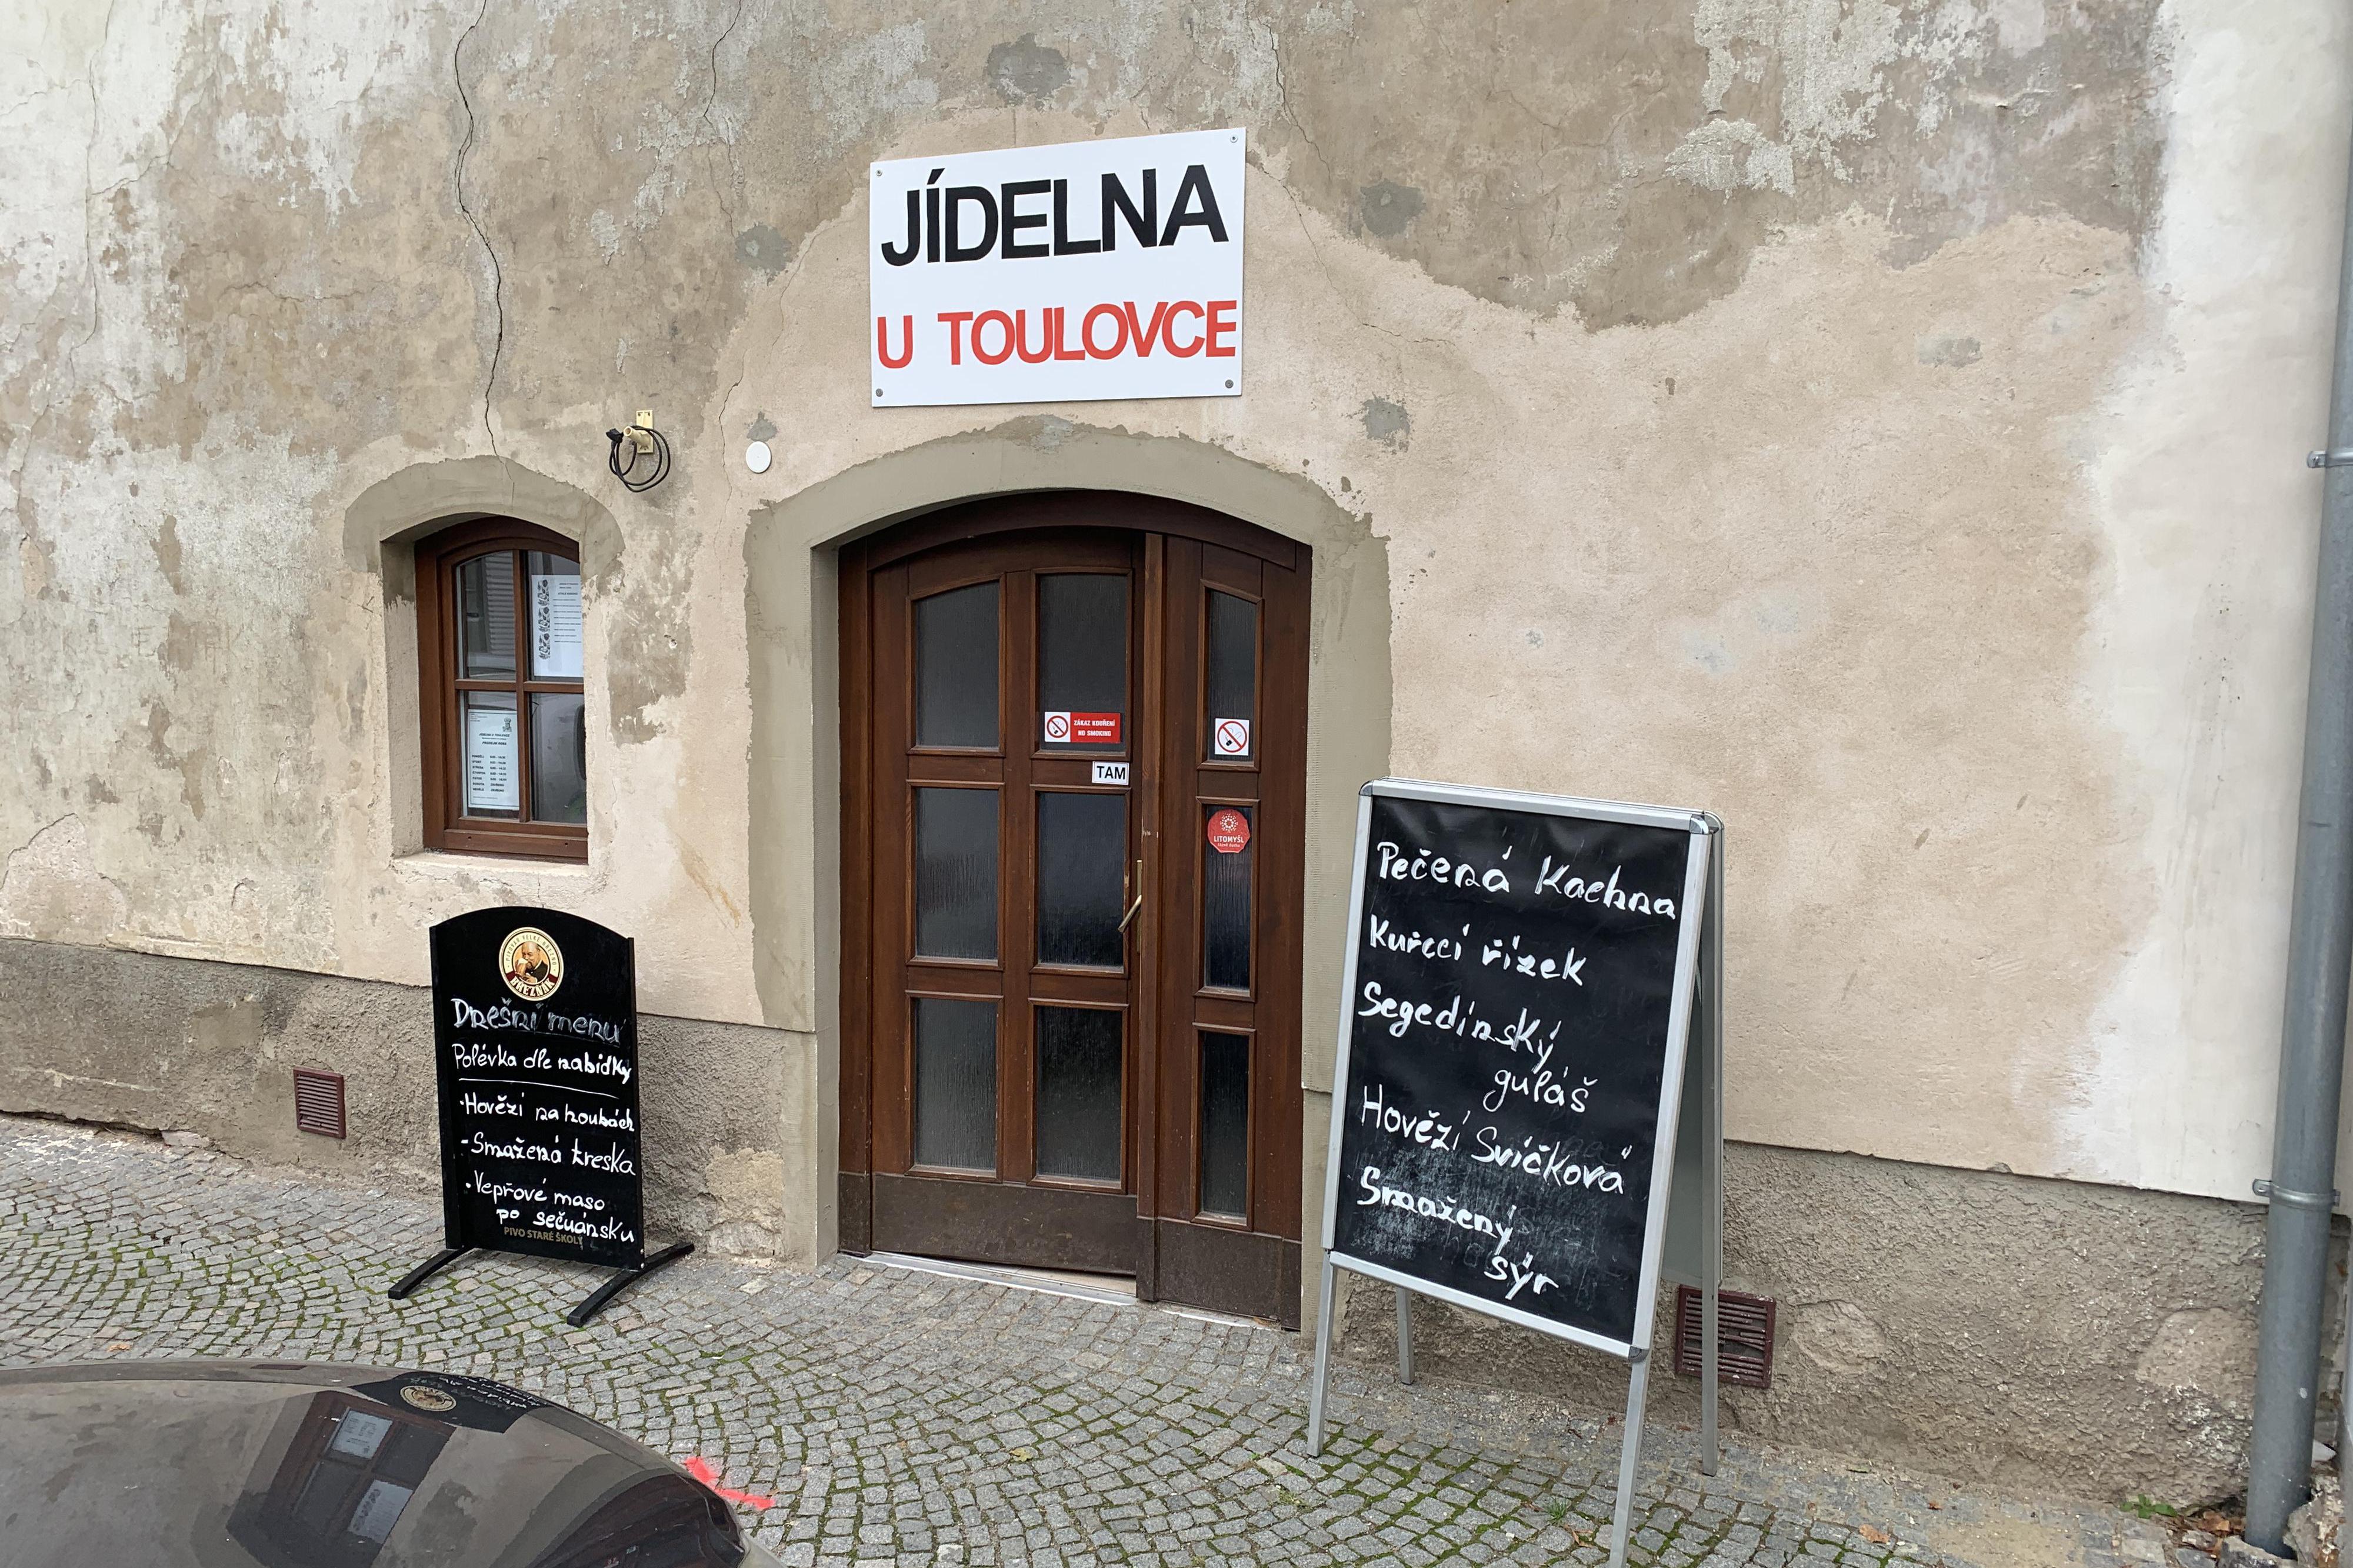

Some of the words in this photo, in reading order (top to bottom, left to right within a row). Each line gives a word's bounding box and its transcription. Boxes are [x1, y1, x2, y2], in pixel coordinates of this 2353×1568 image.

[882, 165, 1229, 266] JÍDELNA
[878, 315, 913, 368] U
[937, 300, 1237, 365] TOULOVCE
[1096, 766, 1125, 779] TAM
[1214, 835, 1244, 843] LITOMYŠL
[1377, 841, 1514, 895] Pečená
[1482, 936, 1587, 986] řízek
[451, 996, 545, 1031] Dnešní
[452, 1043, 517, 1070] Polévka
[524, 1048, 552, 1069] dle
[1482, 1066, 1598, 1113] guláš
[535, 1107, 559, 1121] na
[565, 1103, 635, 1132] houbách
[471, 1132, 562, 1164] Smažená
[1361, 1083, 1471, 1151] Hovězí
[1471, 1126, 1633, 1195] Svíčková
[474, 1170, 548, 1205] Vepřové
[554, 1192, 605, 1210] maso
[496, 1209, 520, 1225] po
[1357, 1165, 1518, 1256] Smažený
[504, 1226, 525, 1237] PIVO
[527, 1229, 554, 1241] STARÉ
[556, 1232, 583, 1245] ŠKOLY
[1483, 1252, 1559, 1300] sýr
